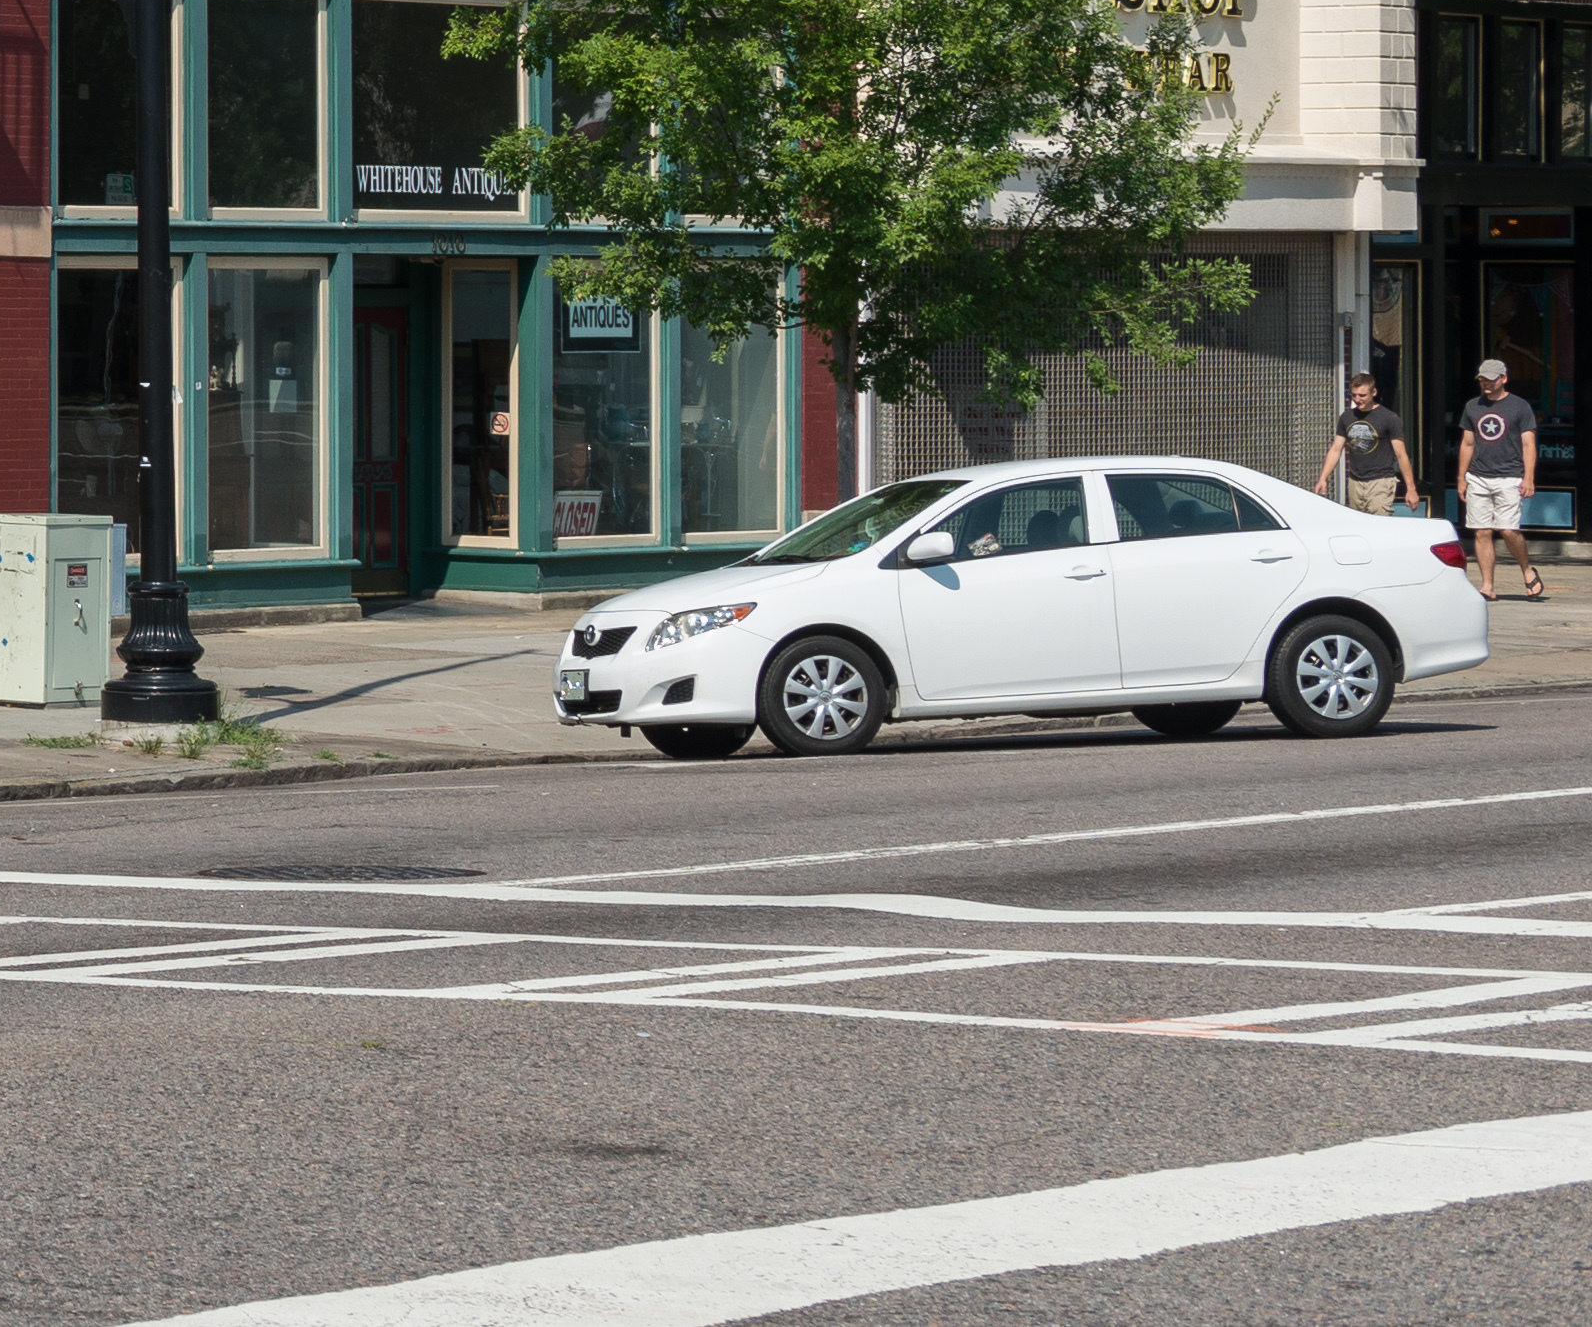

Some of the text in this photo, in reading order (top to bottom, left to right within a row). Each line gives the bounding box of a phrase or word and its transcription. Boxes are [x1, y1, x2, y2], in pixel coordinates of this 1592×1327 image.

[356, 165, 443, 194] WHITEHOUSE
[431, 232, 467, 254] 1010
[571, 304, 631, 329] ANTIQUES
[554, 500, 597, 536] CLOSED
